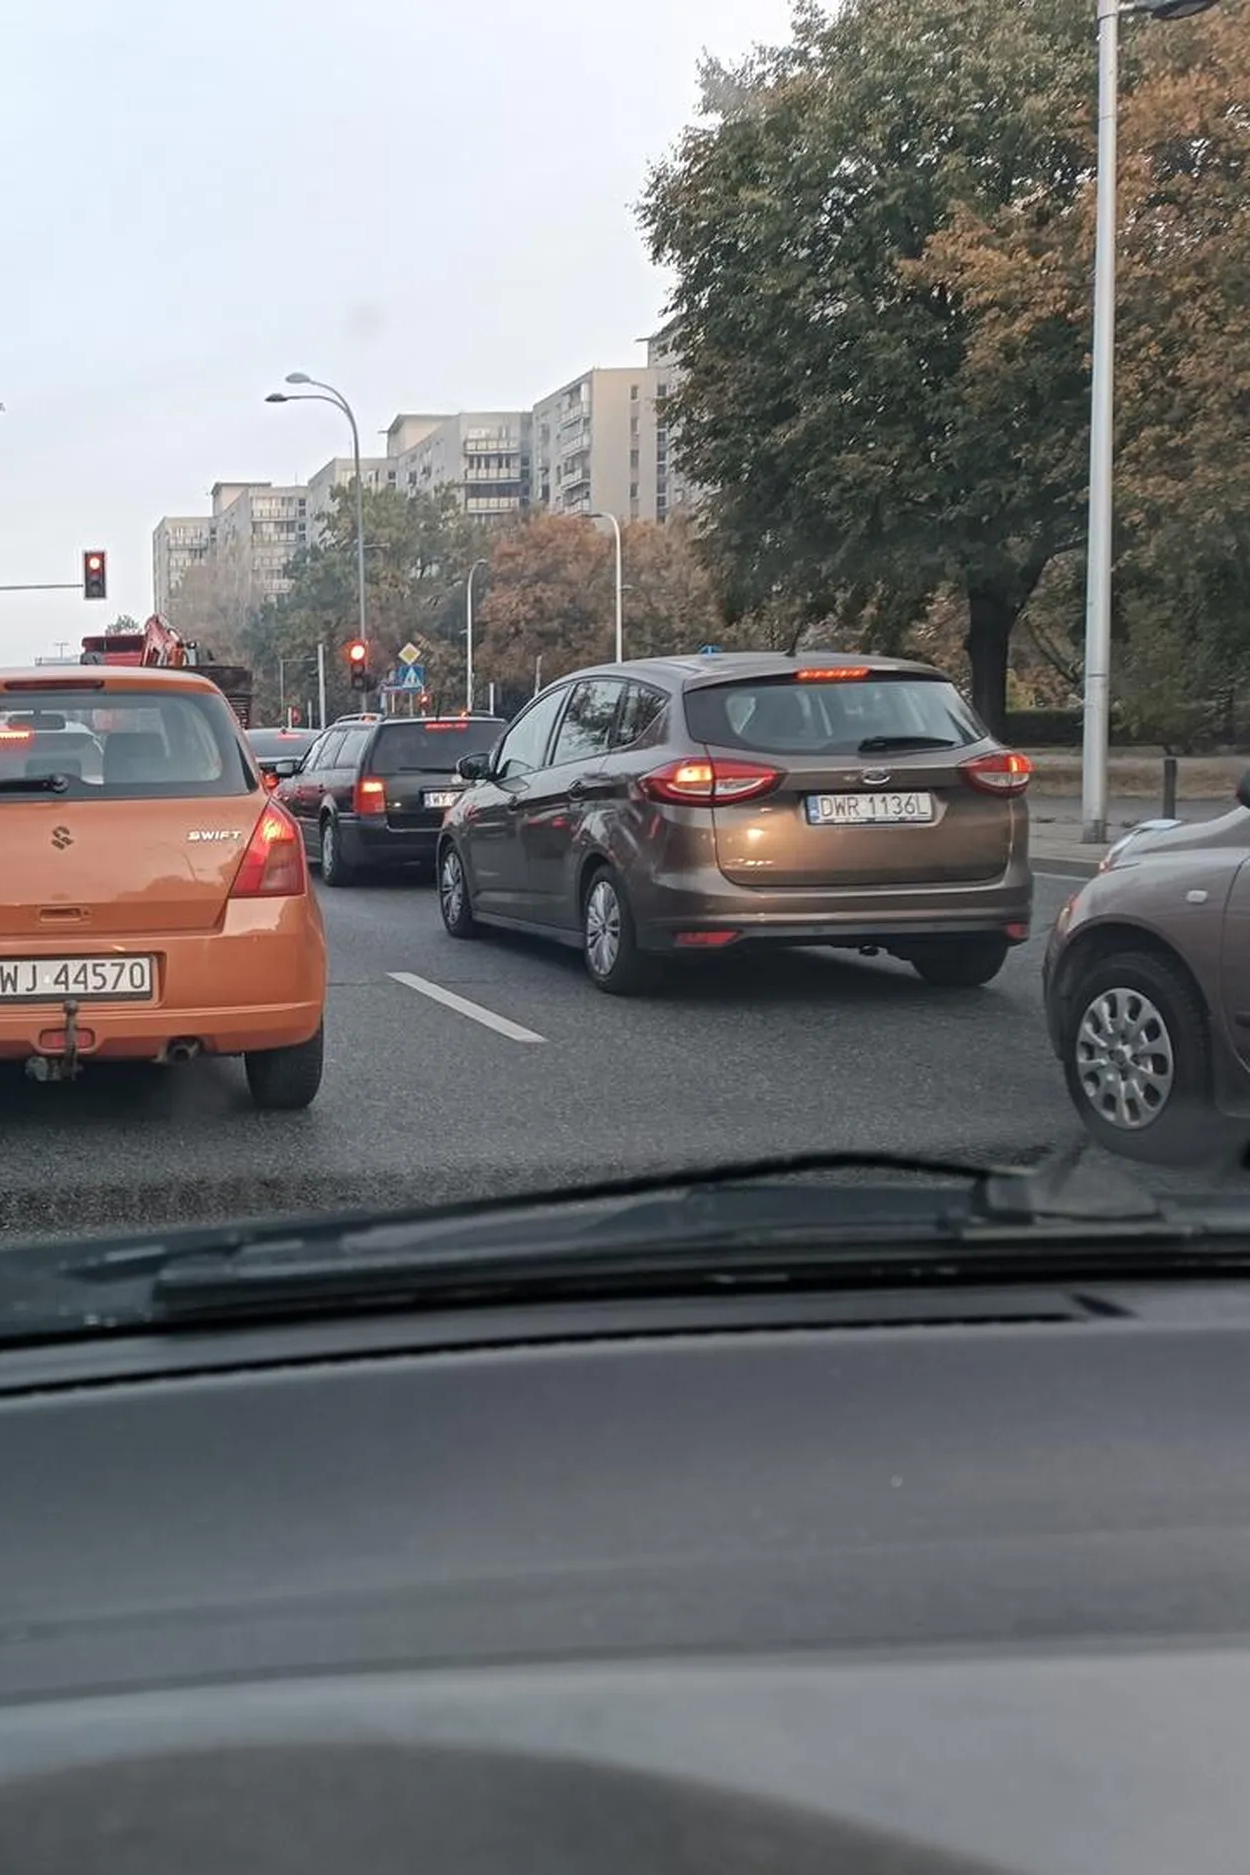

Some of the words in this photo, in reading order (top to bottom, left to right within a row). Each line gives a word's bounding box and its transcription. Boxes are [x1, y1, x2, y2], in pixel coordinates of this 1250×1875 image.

[820, 796, 860, 817] DWR
[869, 794, 929, 816] 1136L
[188, 830, 242, 841] SWIFT
[0, 964, 38, 993] WJ
[53, 961, 146, 992] 44570
